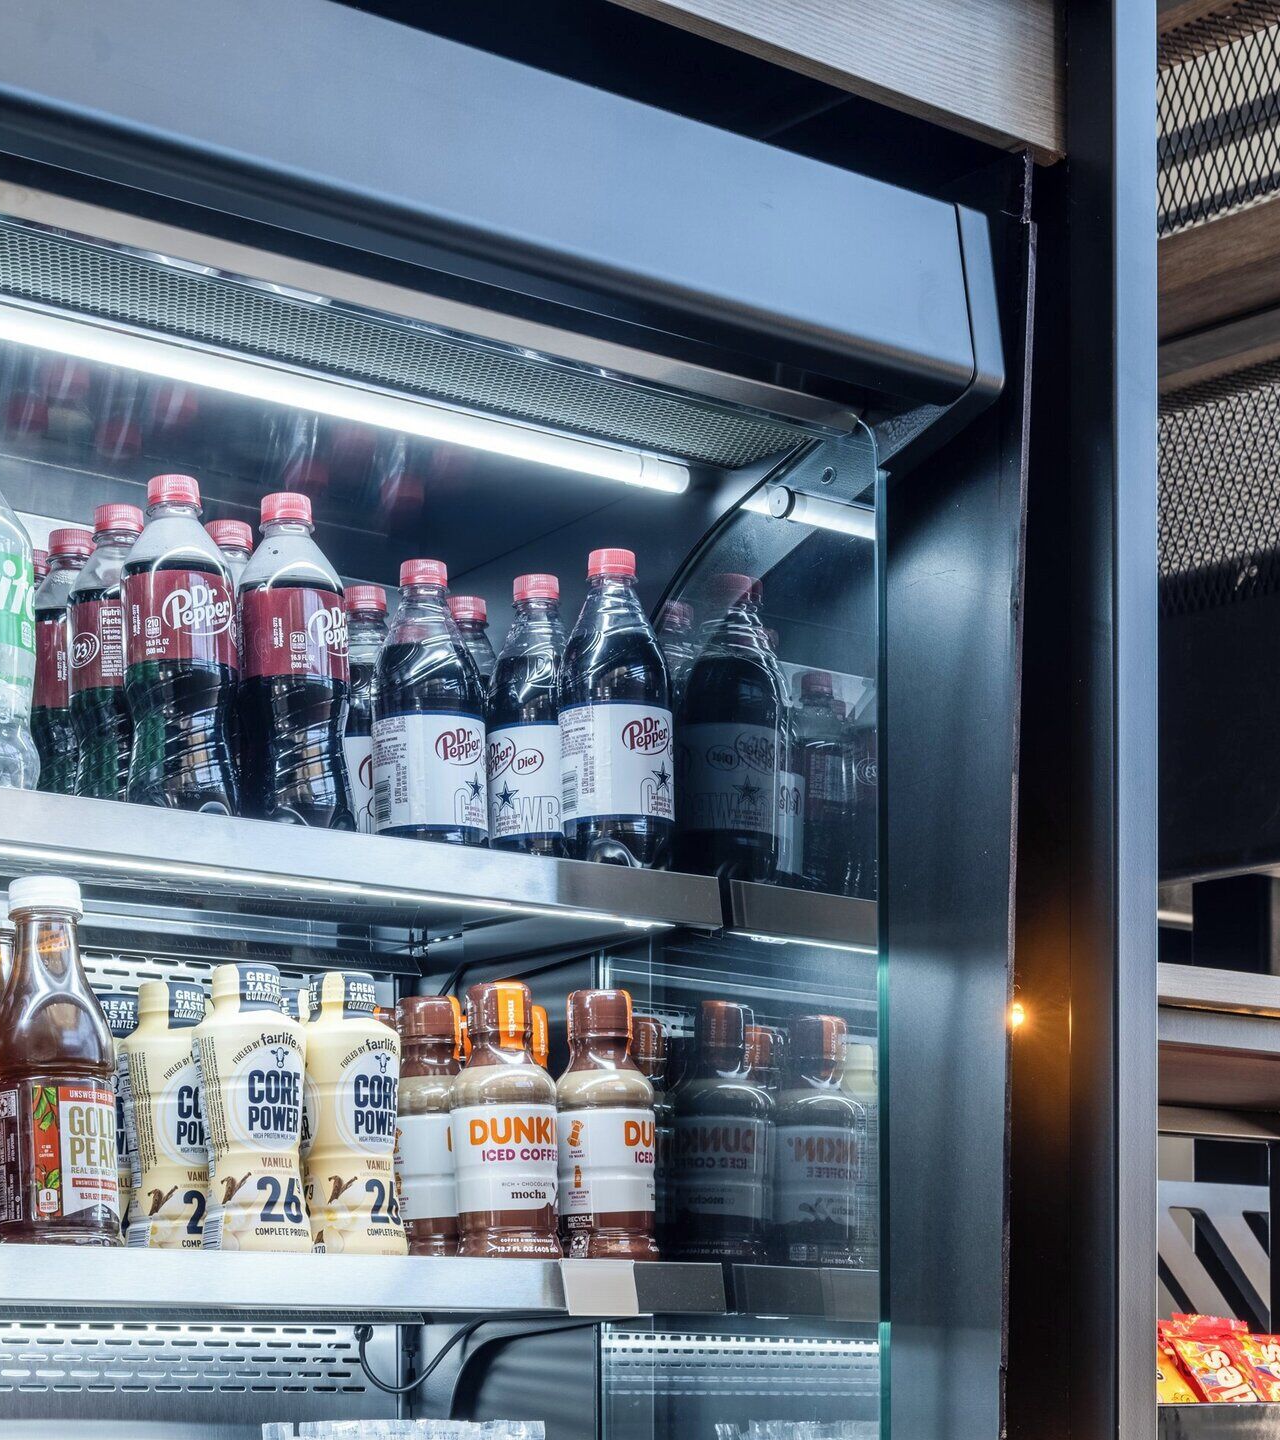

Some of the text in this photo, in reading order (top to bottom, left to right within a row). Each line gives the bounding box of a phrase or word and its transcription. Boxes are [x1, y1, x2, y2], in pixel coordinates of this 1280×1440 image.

[192, 587, 217, 607] Dr
[171, 591, 230, 630] Pepper
[147, 619, 159, 628] 210
[455, 728, 473, 742] Dr
[629, 719, 668, 751] Pepper
[442, 729, 481, 761] Pepper
[517, 754, 538, 771] Diet
[246, 972, 280, 985] GREAT
[247, 982, 281, 995] TASTE
[349, 982, 374, 993] GREAT
[349, 992, 376, 1003] TASTE
[506, 999, 517, 1039] mocha
[232, 1045, 252, 1065] FUELED
[252, 1040, 261, 1049] BY
[248, 1070, 300, 1106] CORE
[354, 1074, 398, 1111] CORE
[69, 1106, 116, 1137] GOLD
[248, 1106, 298, 1133] POWER
[470, 1116, 557, 1146] DUNKI
[69, 1137, 116, 1166] PEAK
[482, 1150, 515, 1162] ICED
[634, 1151, 654, 1163] ICED
[261, 1157, 292, 1169] VANILLA
[366, 1160, 390, 1171] VANILLA
[511, 1190, 546, 1200] mocha
[255, 1227, 290, 1237] COMPLETE
[367, 1228, 393, 1237] COMPLETE
